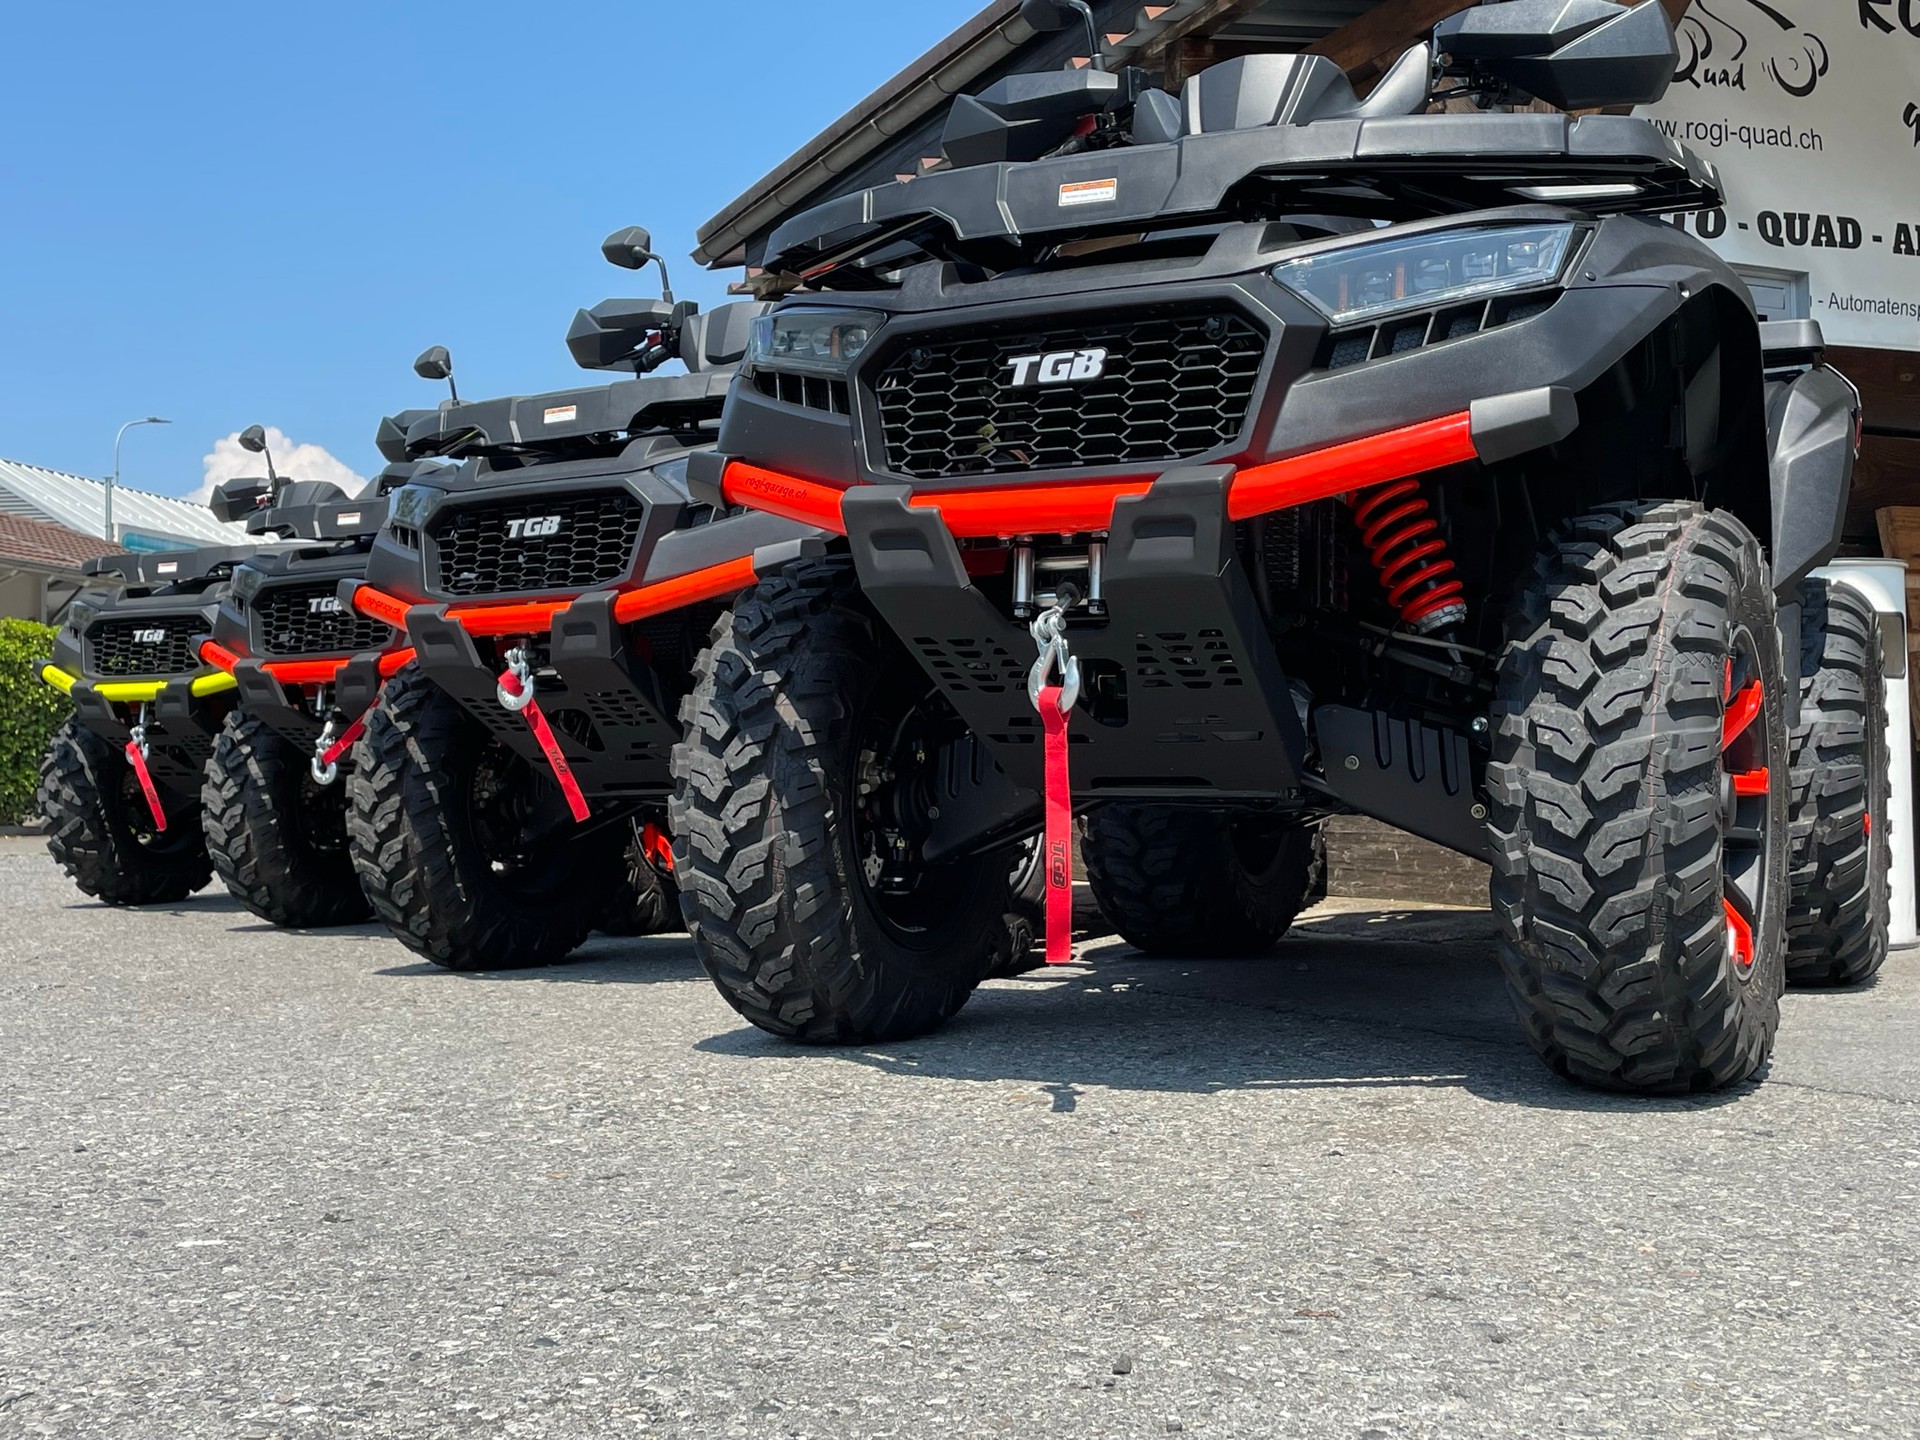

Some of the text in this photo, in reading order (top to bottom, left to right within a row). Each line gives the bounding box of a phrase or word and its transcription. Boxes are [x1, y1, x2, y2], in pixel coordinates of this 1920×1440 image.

[1647, 118, 1823, 151] w.rogi-quad.ch
[1757, 210, 1862, 250] QUAD
[1008, 348, 1106, 385] TGB
[507, 515, 561, 538] TGB
[133, 629, 165, 642] TGB
[1050, 839, 1067, 889] TGB
